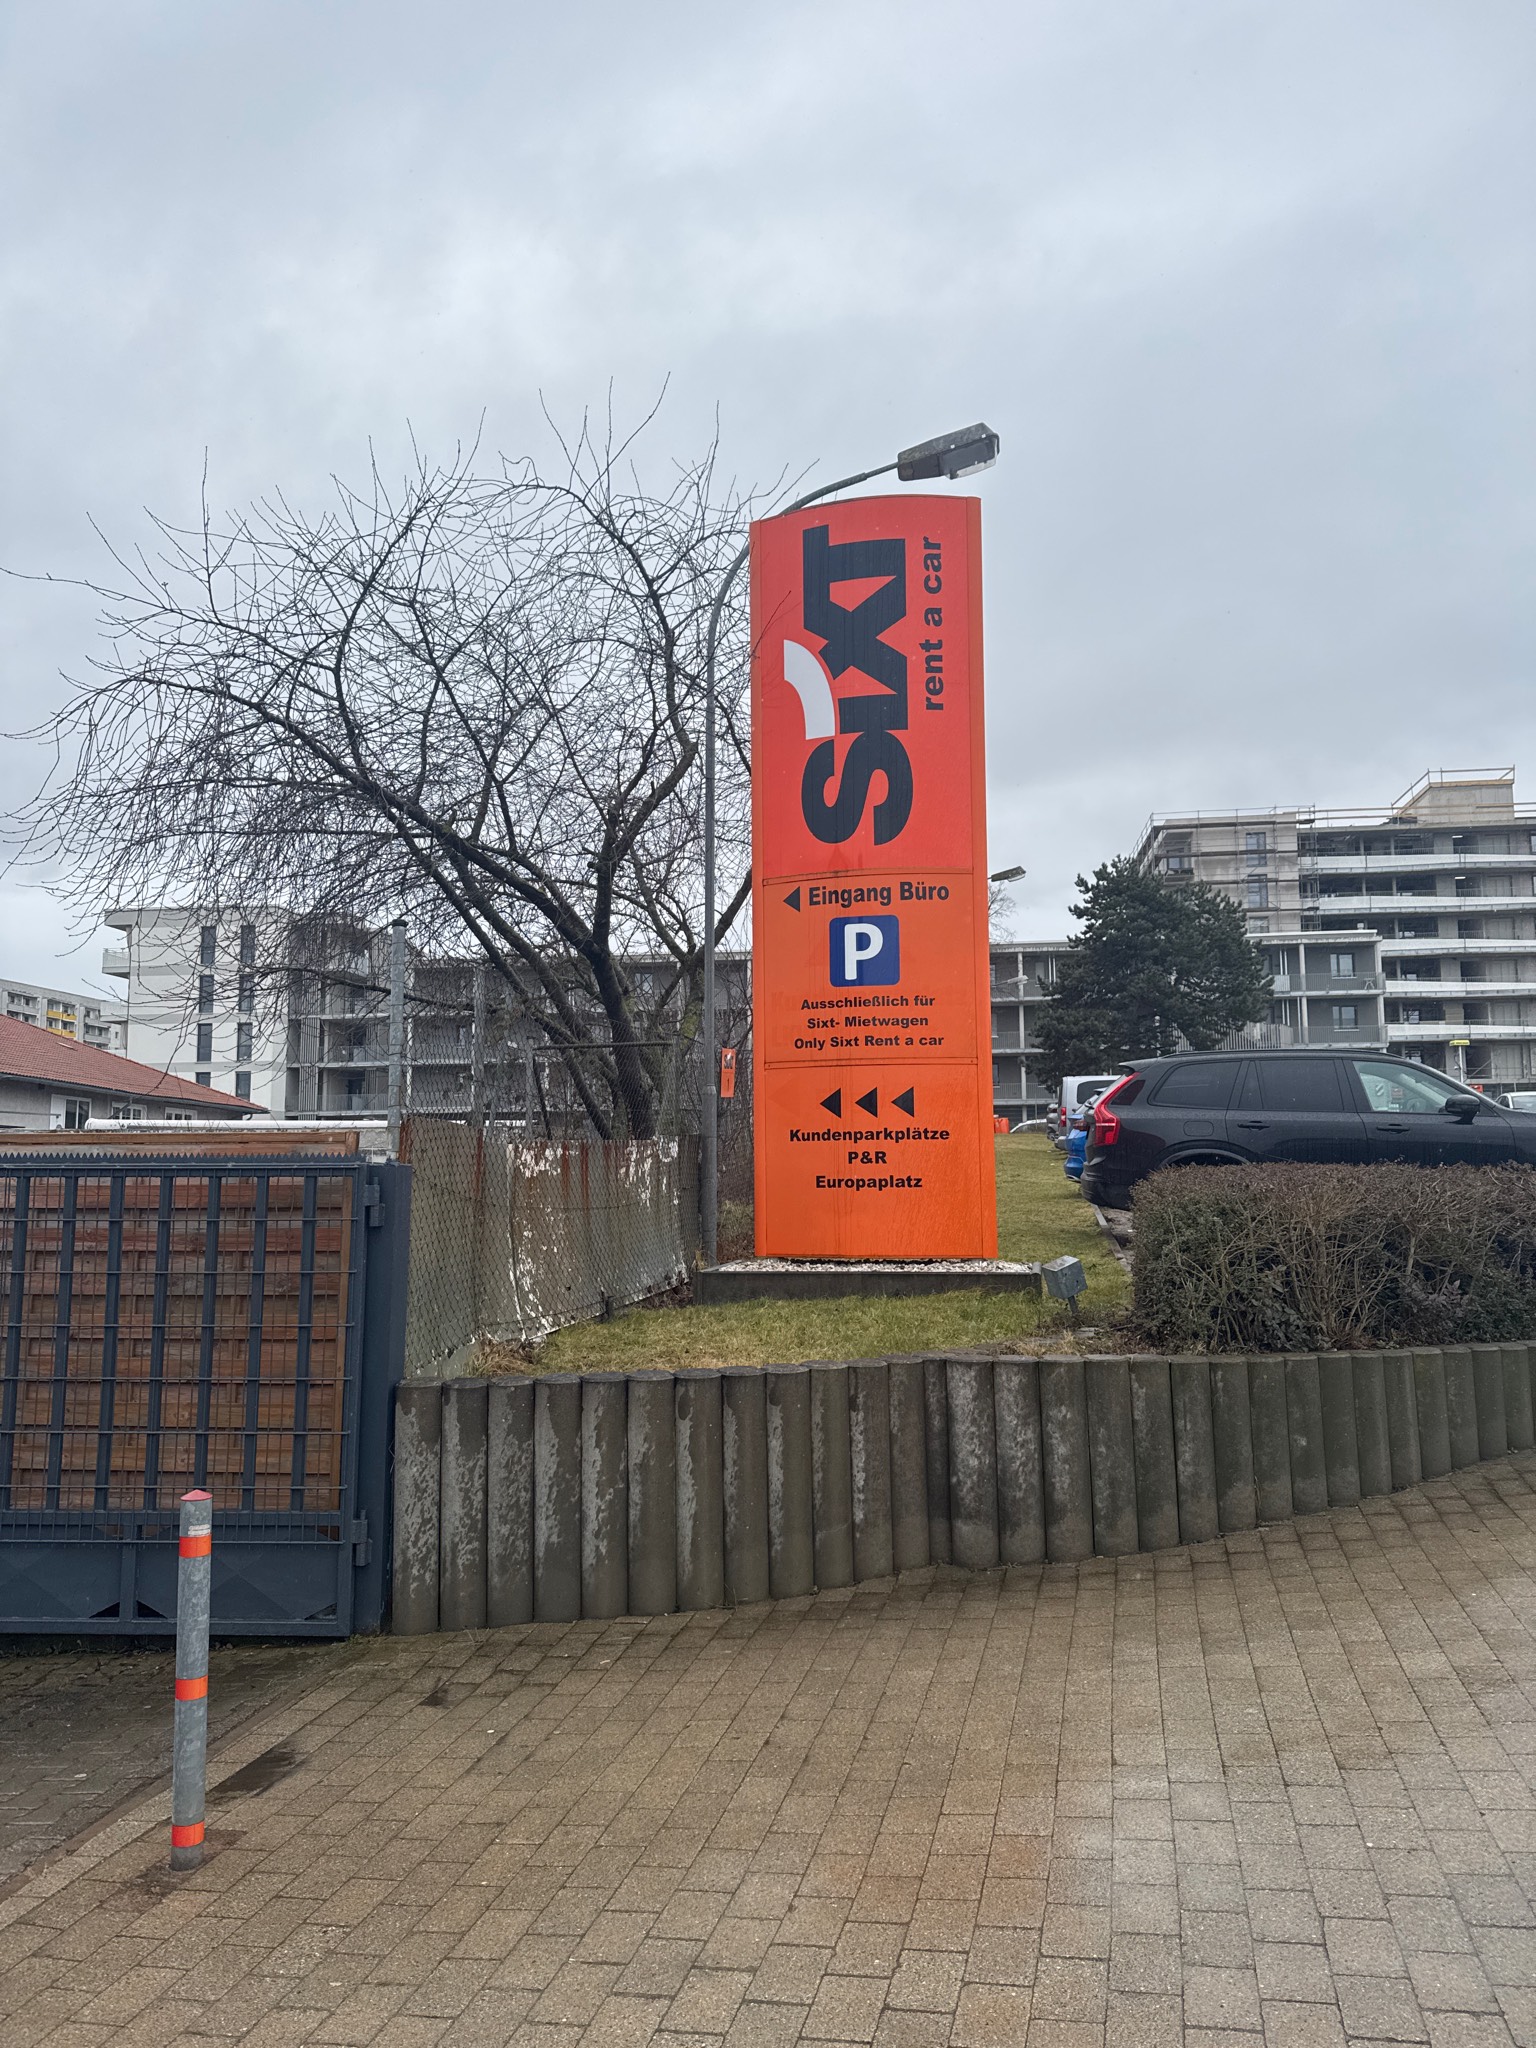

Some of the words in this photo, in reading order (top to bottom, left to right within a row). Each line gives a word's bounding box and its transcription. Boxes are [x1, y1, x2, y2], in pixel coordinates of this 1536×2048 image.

[923, 536, 943, 594] car
[924, 606, 943, 627] a
[919, 638, 944, 711] rent
[784, 524, 913, 846] SIXT
[808, 885, 892, 908] Eingang
[899, 881, 950, 901] Büro
[844, 922, 884, 981] P
[801, 996, 909, 1010] Ausschließlich
[914, 995, 935, 1007] für
[807, 1017, 840, 1029] Sixt-
[844, 1016, 929, 1028] Mietwagen
[794, 1038, 826, 1050] Only
[830, 1036, 860, 1048] Sixt
[864, 1035, 900, 1046] Rent
[904, 1037, 914, 1046] a
[919, 1035, 944, 1045] car
[789, 1127, 950, 1143] Kundenparkplätze
[847, 1151, 887, 1164] P&R
[815, 1174, 923, 1191] Europaplatz
